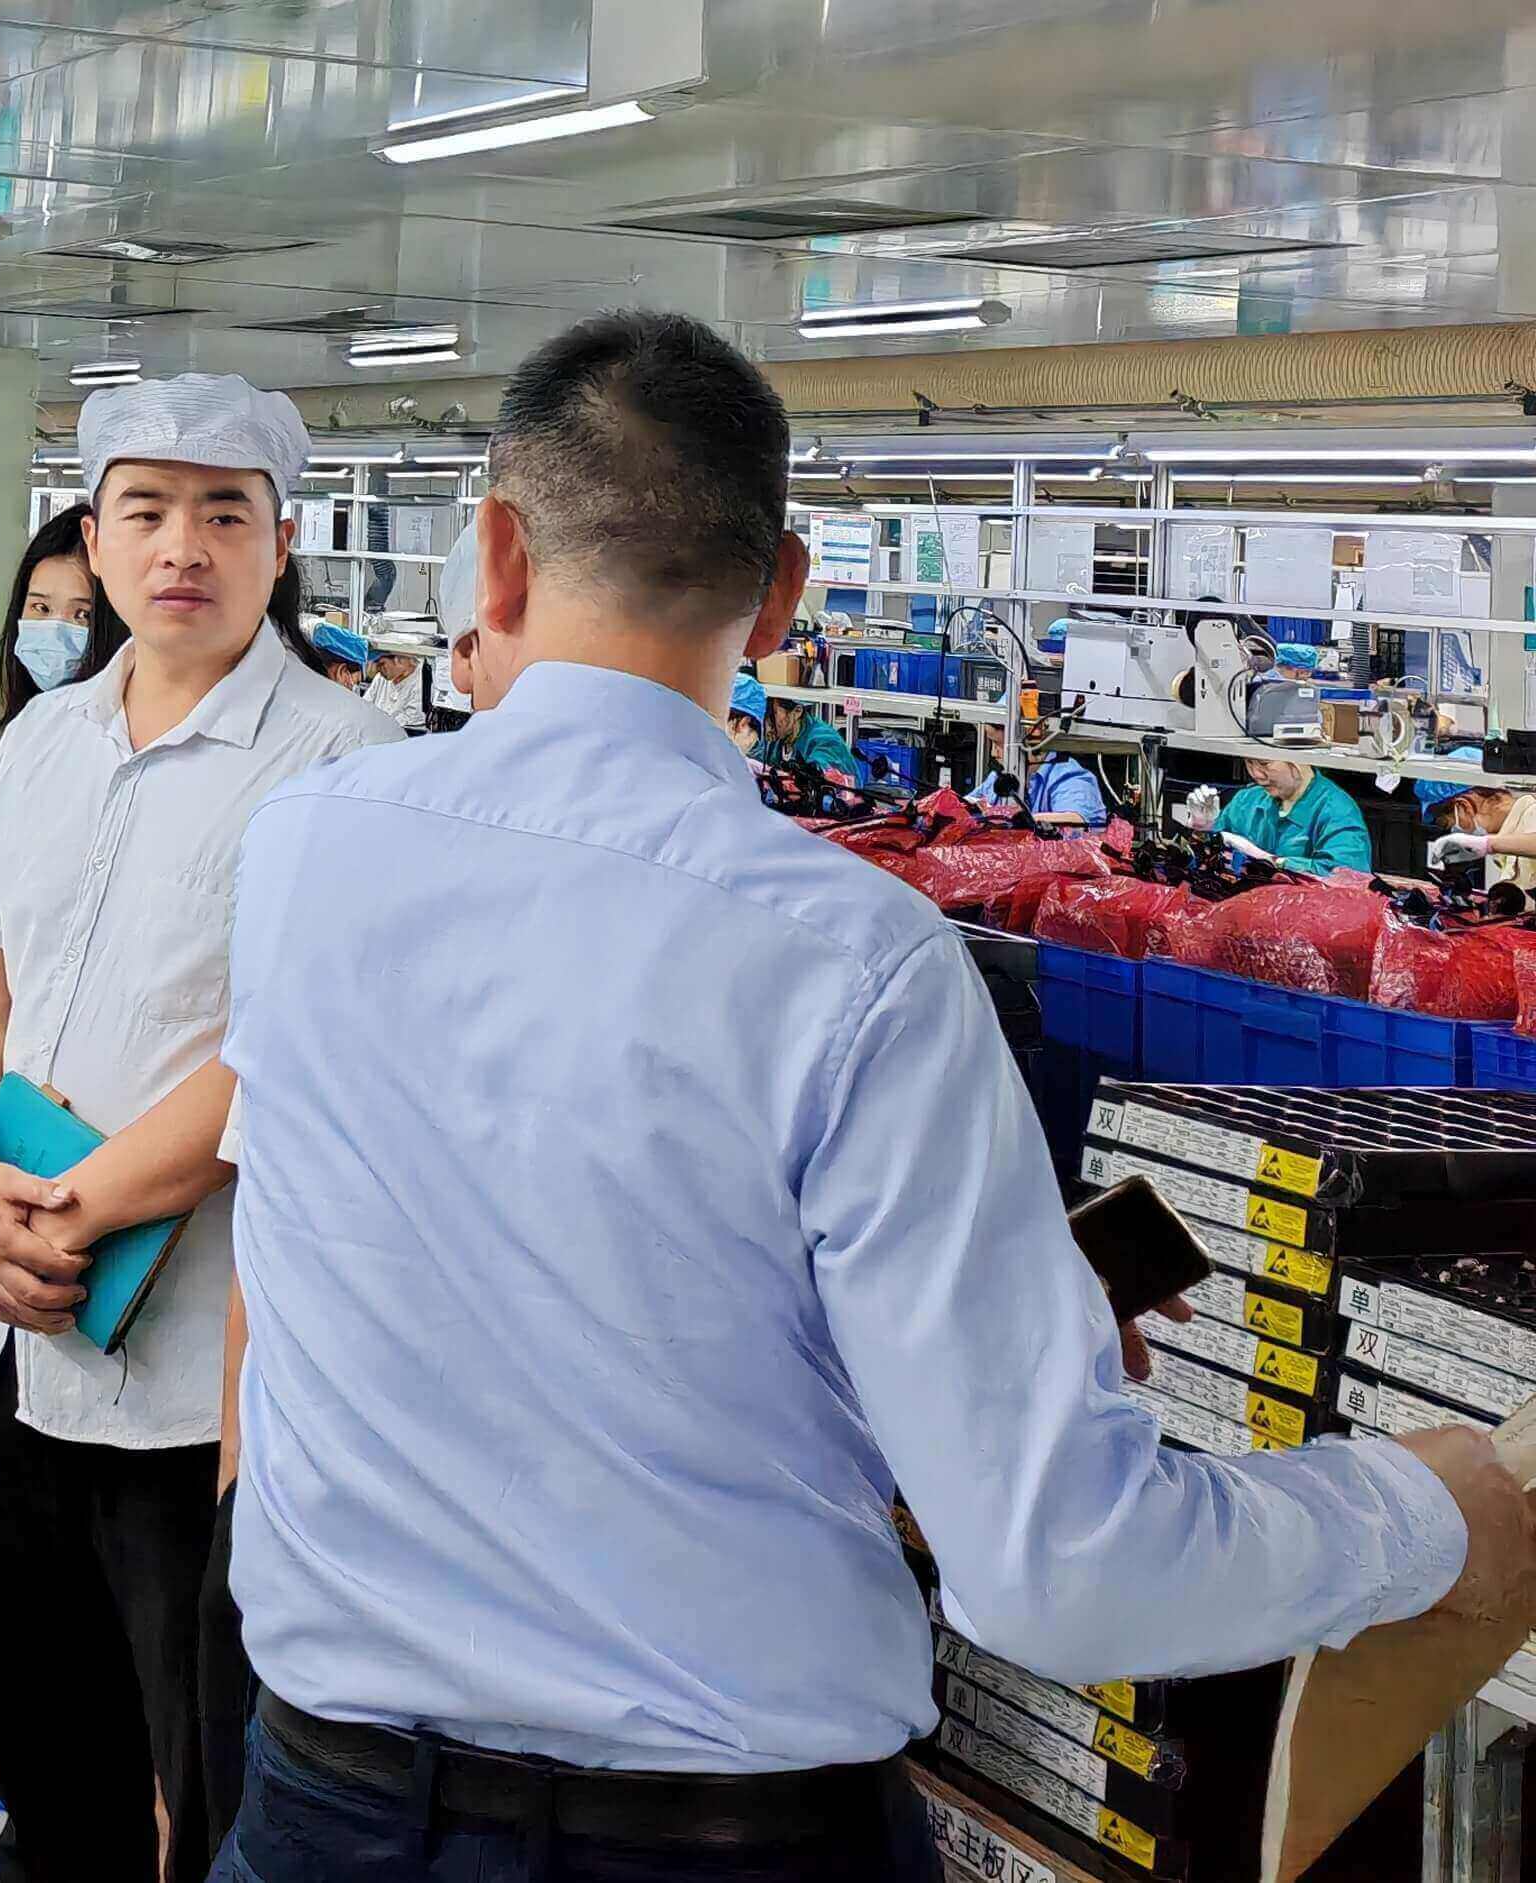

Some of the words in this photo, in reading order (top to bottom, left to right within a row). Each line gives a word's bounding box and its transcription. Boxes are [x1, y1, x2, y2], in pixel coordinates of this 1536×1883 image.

[1095, 1105, 1117, 1132] 双
[1088, 1155, 1104, 1181] 单
[1349, 1285, 1371, 1315] 单
[1355, 1327, 1379, 1359] 双
[1346, 1385, 1368, 1415] 单
